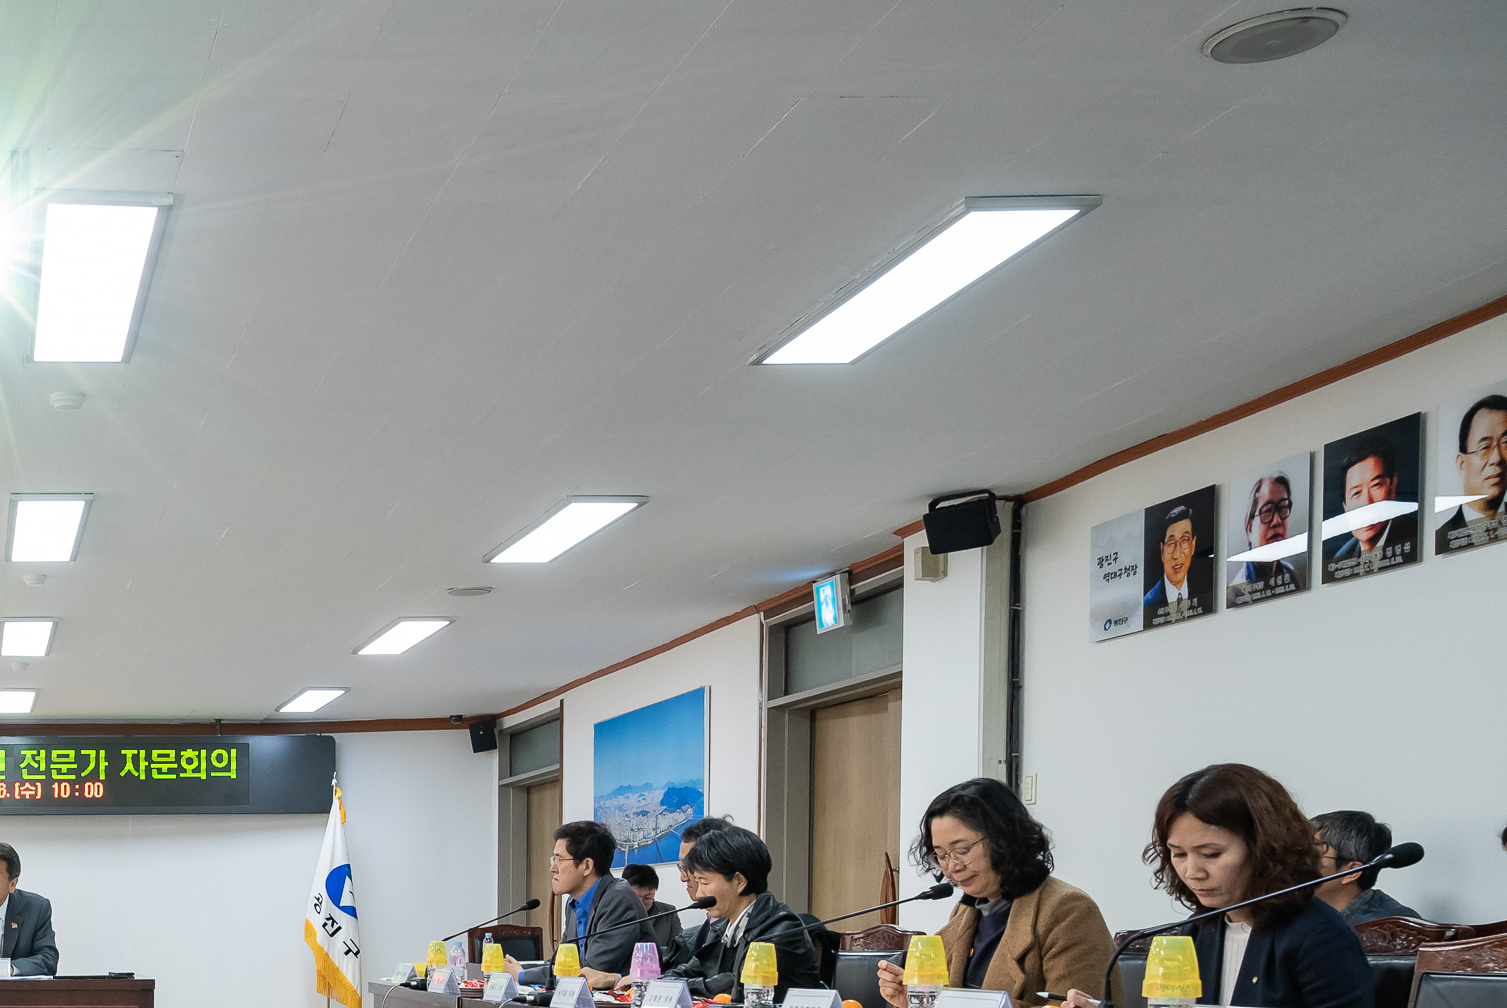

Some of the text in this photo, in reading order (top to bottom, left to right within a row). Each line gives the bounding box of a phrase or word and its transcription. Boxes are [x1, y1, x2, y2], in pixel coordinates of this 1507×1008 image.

[1096, 551, 1119, 569] 광진구
[1103, 563, 1139, 583] 역대구청장
[18, 748, 109, 780] 전문가
[119, 748, 237, 780] 자문회의
[313, 892, 361, 959] 광진구
